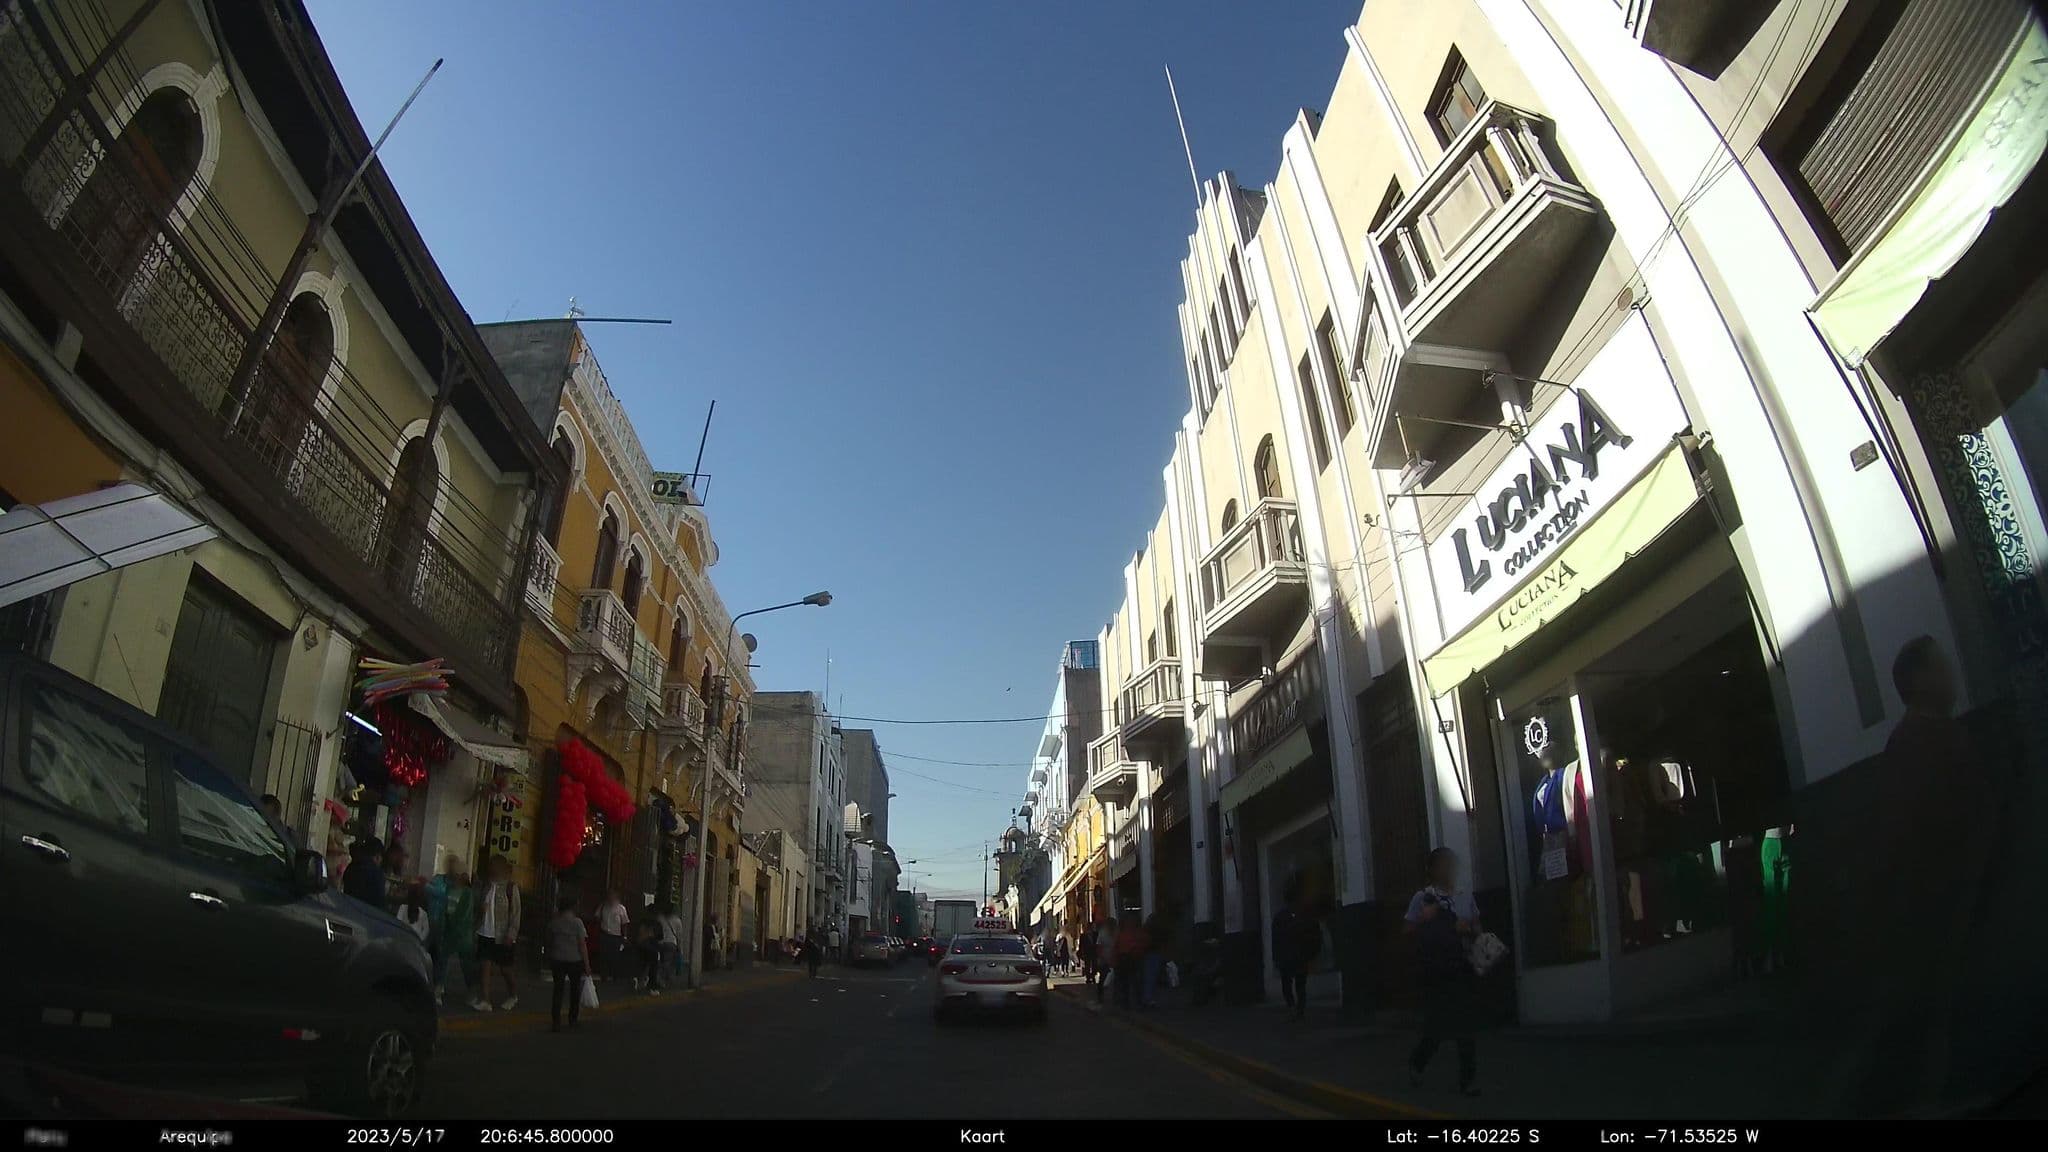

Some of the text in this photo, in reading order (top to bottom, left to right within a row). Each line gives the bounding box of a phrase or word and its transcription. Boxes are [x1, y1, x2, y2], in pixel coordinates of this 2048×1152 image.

[1450, 387, 1634, 595] LUCIANA
[1504, 489, 1590, 576] COLLECTION
[1497, 560, 1579, 632] LUCIANA
[974, 920, 1007, 930] 442525
